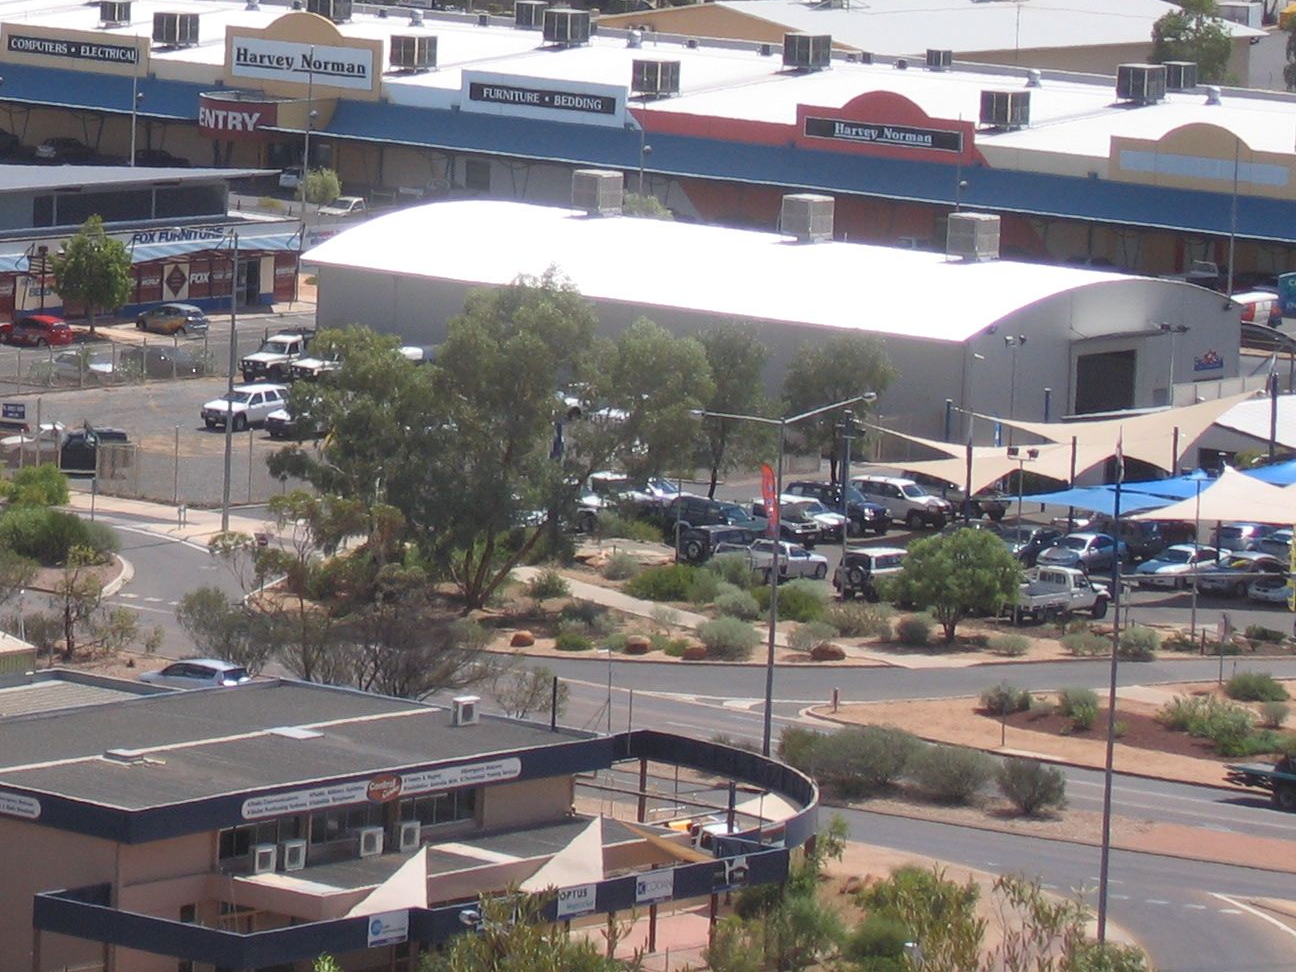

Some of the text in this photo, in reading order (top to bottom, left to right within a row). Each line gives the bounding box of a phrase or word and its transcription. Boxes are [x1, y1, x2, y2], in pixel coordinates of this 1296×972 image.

[10, 38, 136, 61] COMPUTERS ELECTRICAL
[236, 47, 366, 74] Harvey Norman
[483, 87, 602, 110] FURNITURE BEDDING
[199, 106, 261, 131] ENTRY
[834, 122, 932, 143] Harvey Norman
[132, 232, 154, 244] FOX
[190, 272, 210, 284] FOX
[560, 889, 588, 900] OPTUS
